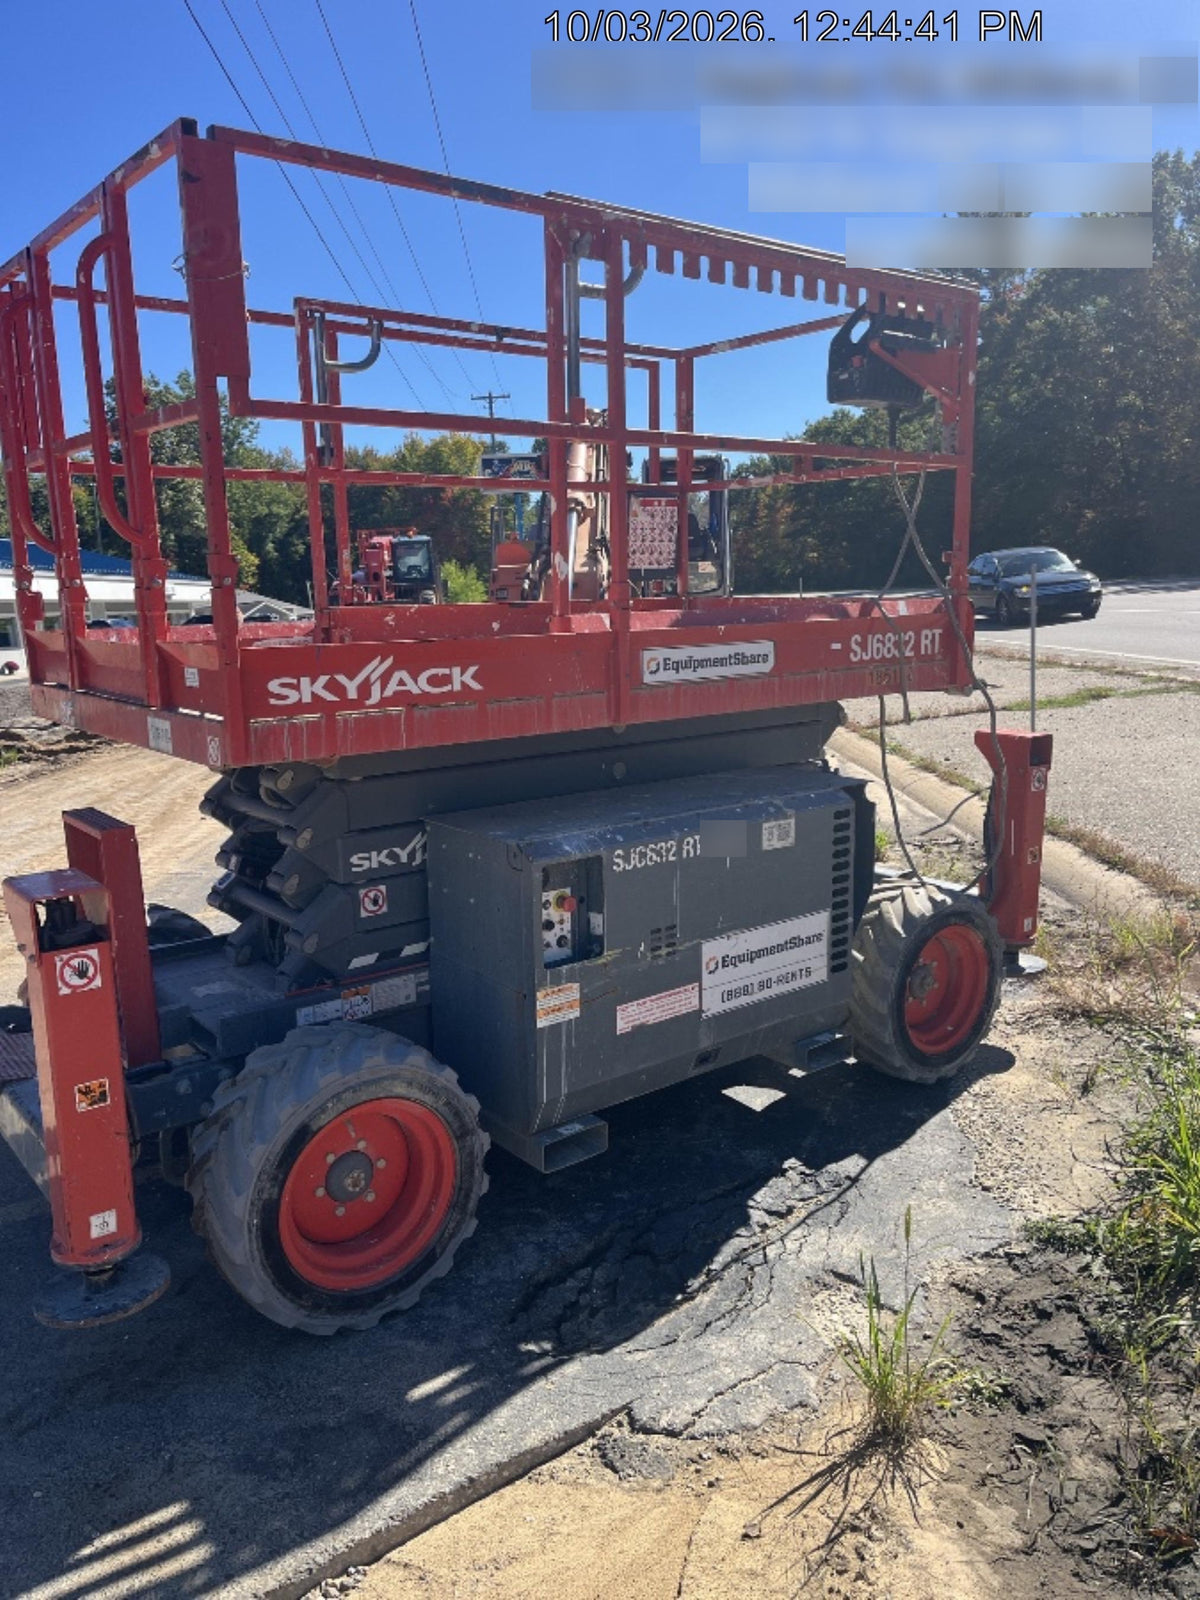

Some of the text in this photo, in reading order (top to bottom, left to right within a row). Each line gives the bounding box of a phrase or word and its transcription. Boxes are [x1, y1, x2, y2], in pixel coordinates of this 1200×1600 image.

[921, 628, 943, 655] RT
[662, 652, 769, 674] EquipmentShare
[267, 655, 484, 706] SKYJACK
[721, 933, 824, 969] EquipmentShare
